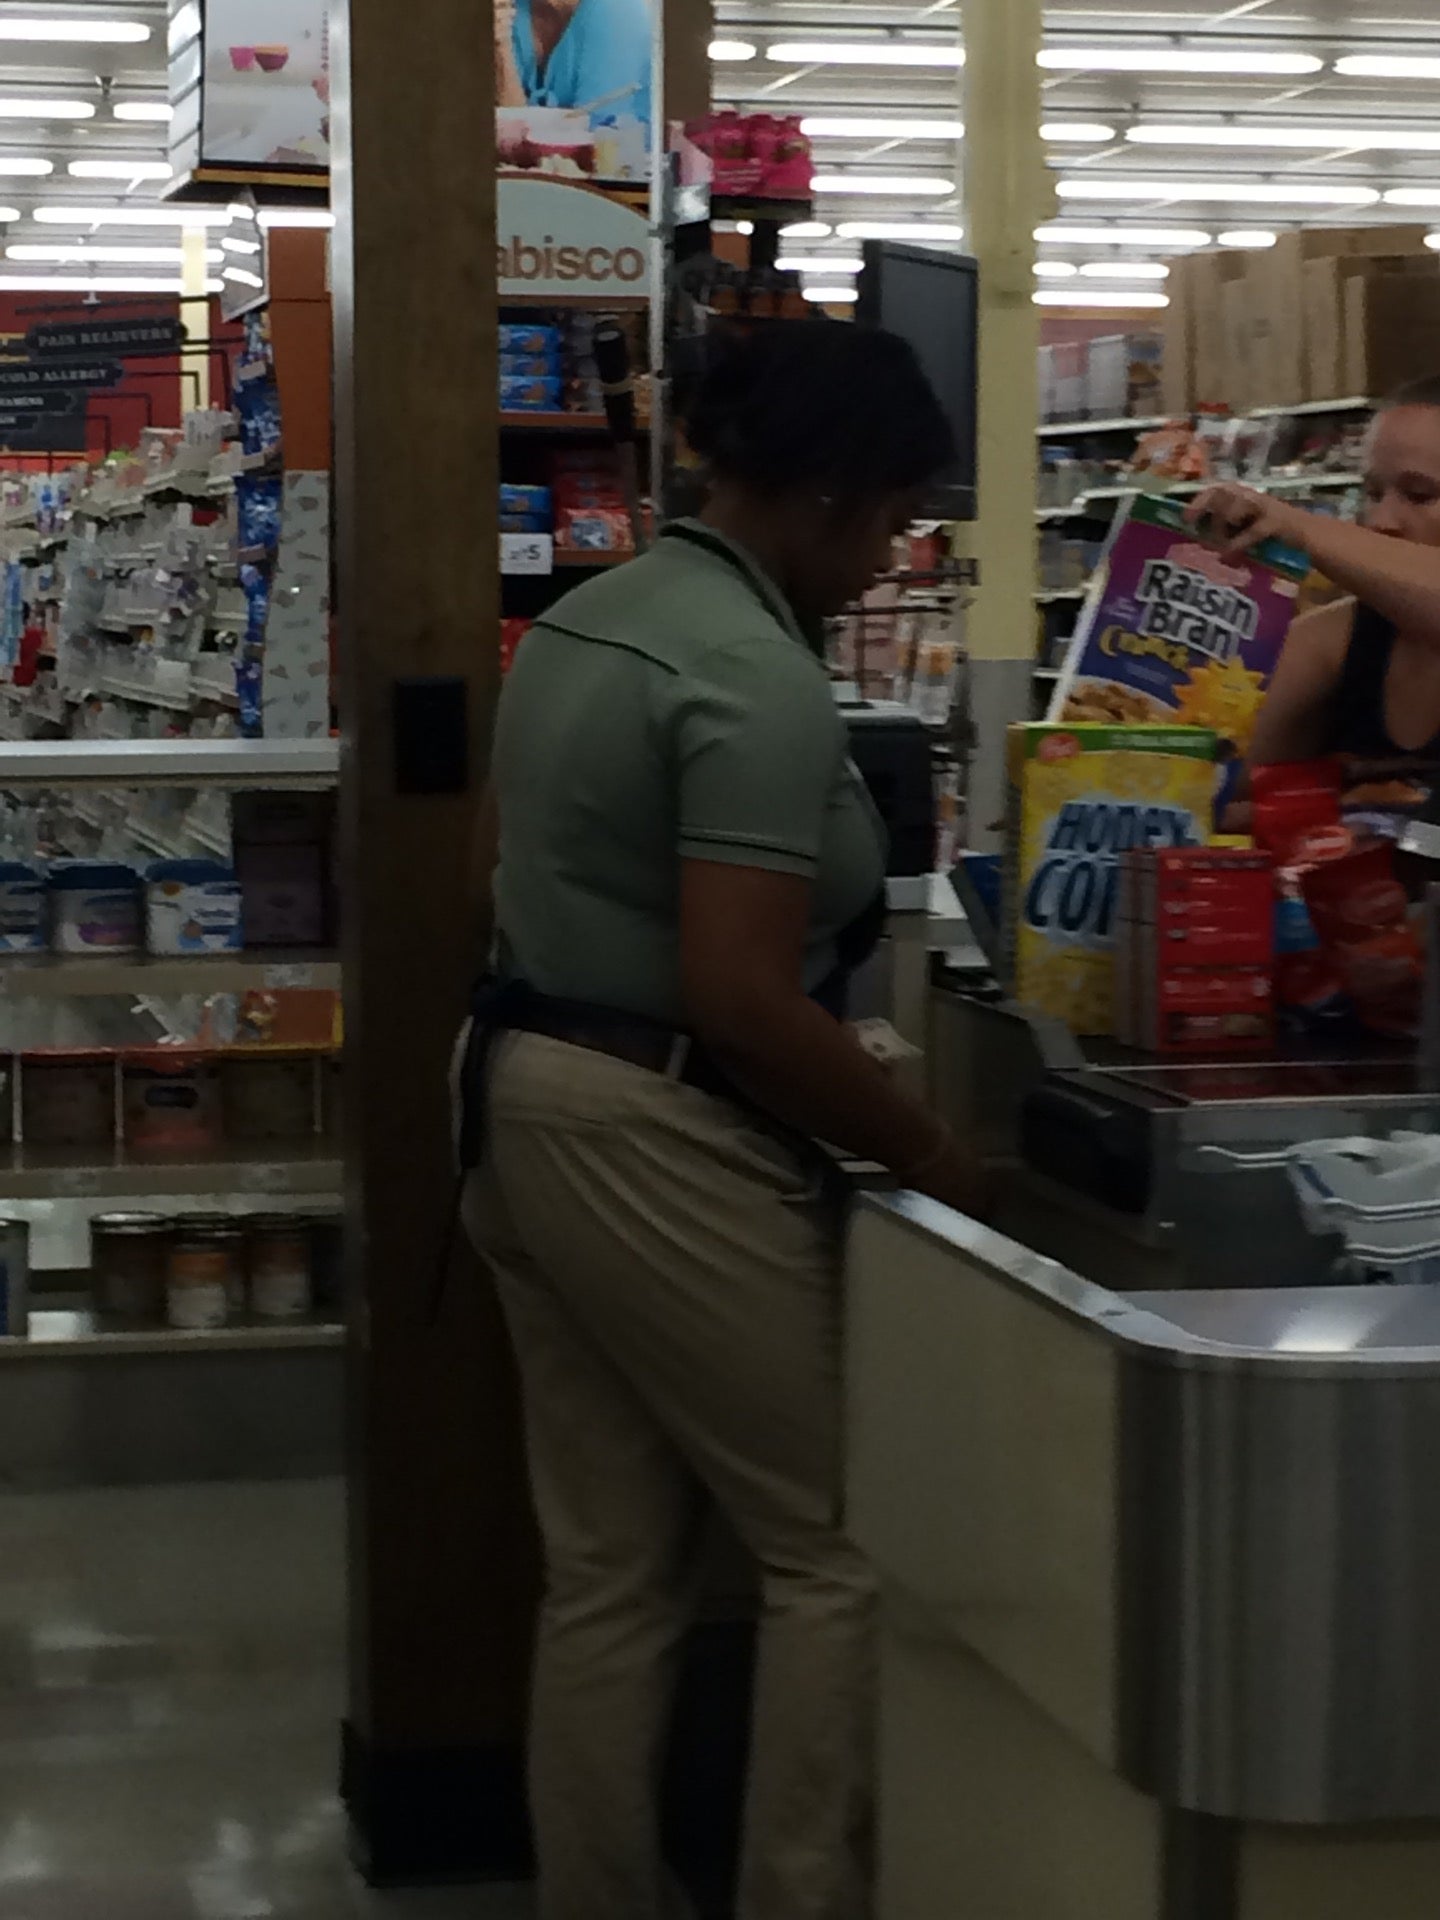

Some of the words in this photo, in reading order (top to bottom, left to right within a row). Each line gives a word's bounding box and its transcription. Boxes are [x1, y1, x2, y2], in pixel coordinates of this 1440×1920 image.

[496, 235, 645, 281] abisco
[1143, 563, 1254, 637] Raisin
[1147, 601, 1237, 662] Bran
